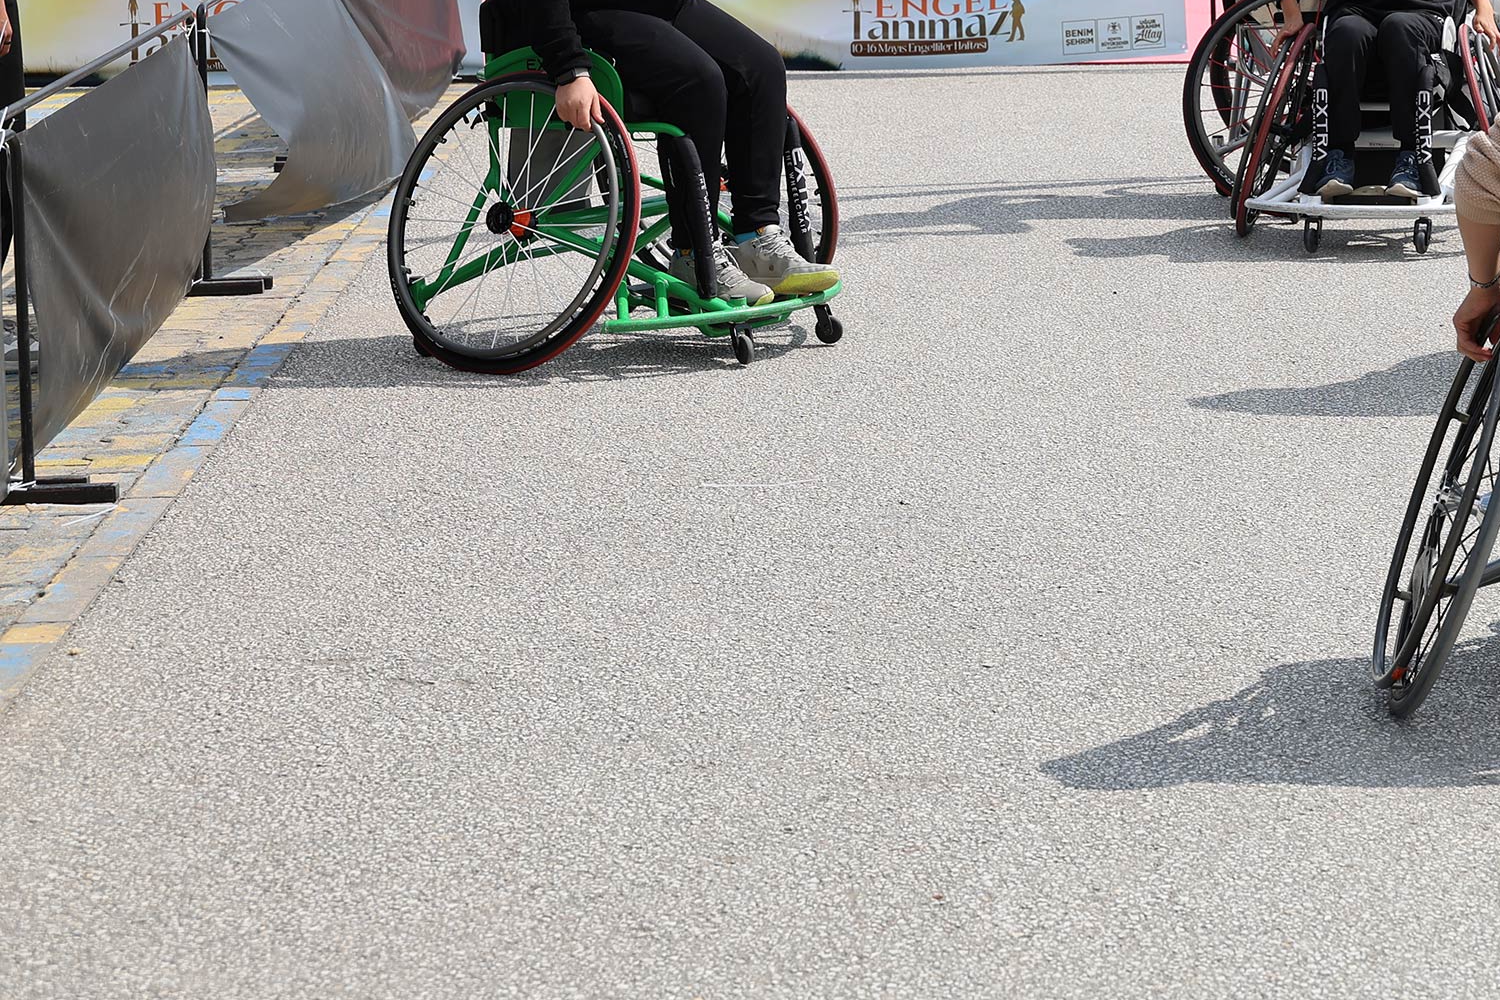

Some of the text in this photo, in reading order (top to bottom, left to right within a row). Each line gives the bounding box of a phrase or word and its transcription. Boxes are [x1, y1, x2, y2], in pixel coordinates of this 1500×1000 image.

[842, 10, 1011, 40] Tanımaz
[1065, 28, 1094, 38] BENİM
[1315, 88, 1328, 162] EXTRA
[1418, 90, 1432, 163] EXTRA
